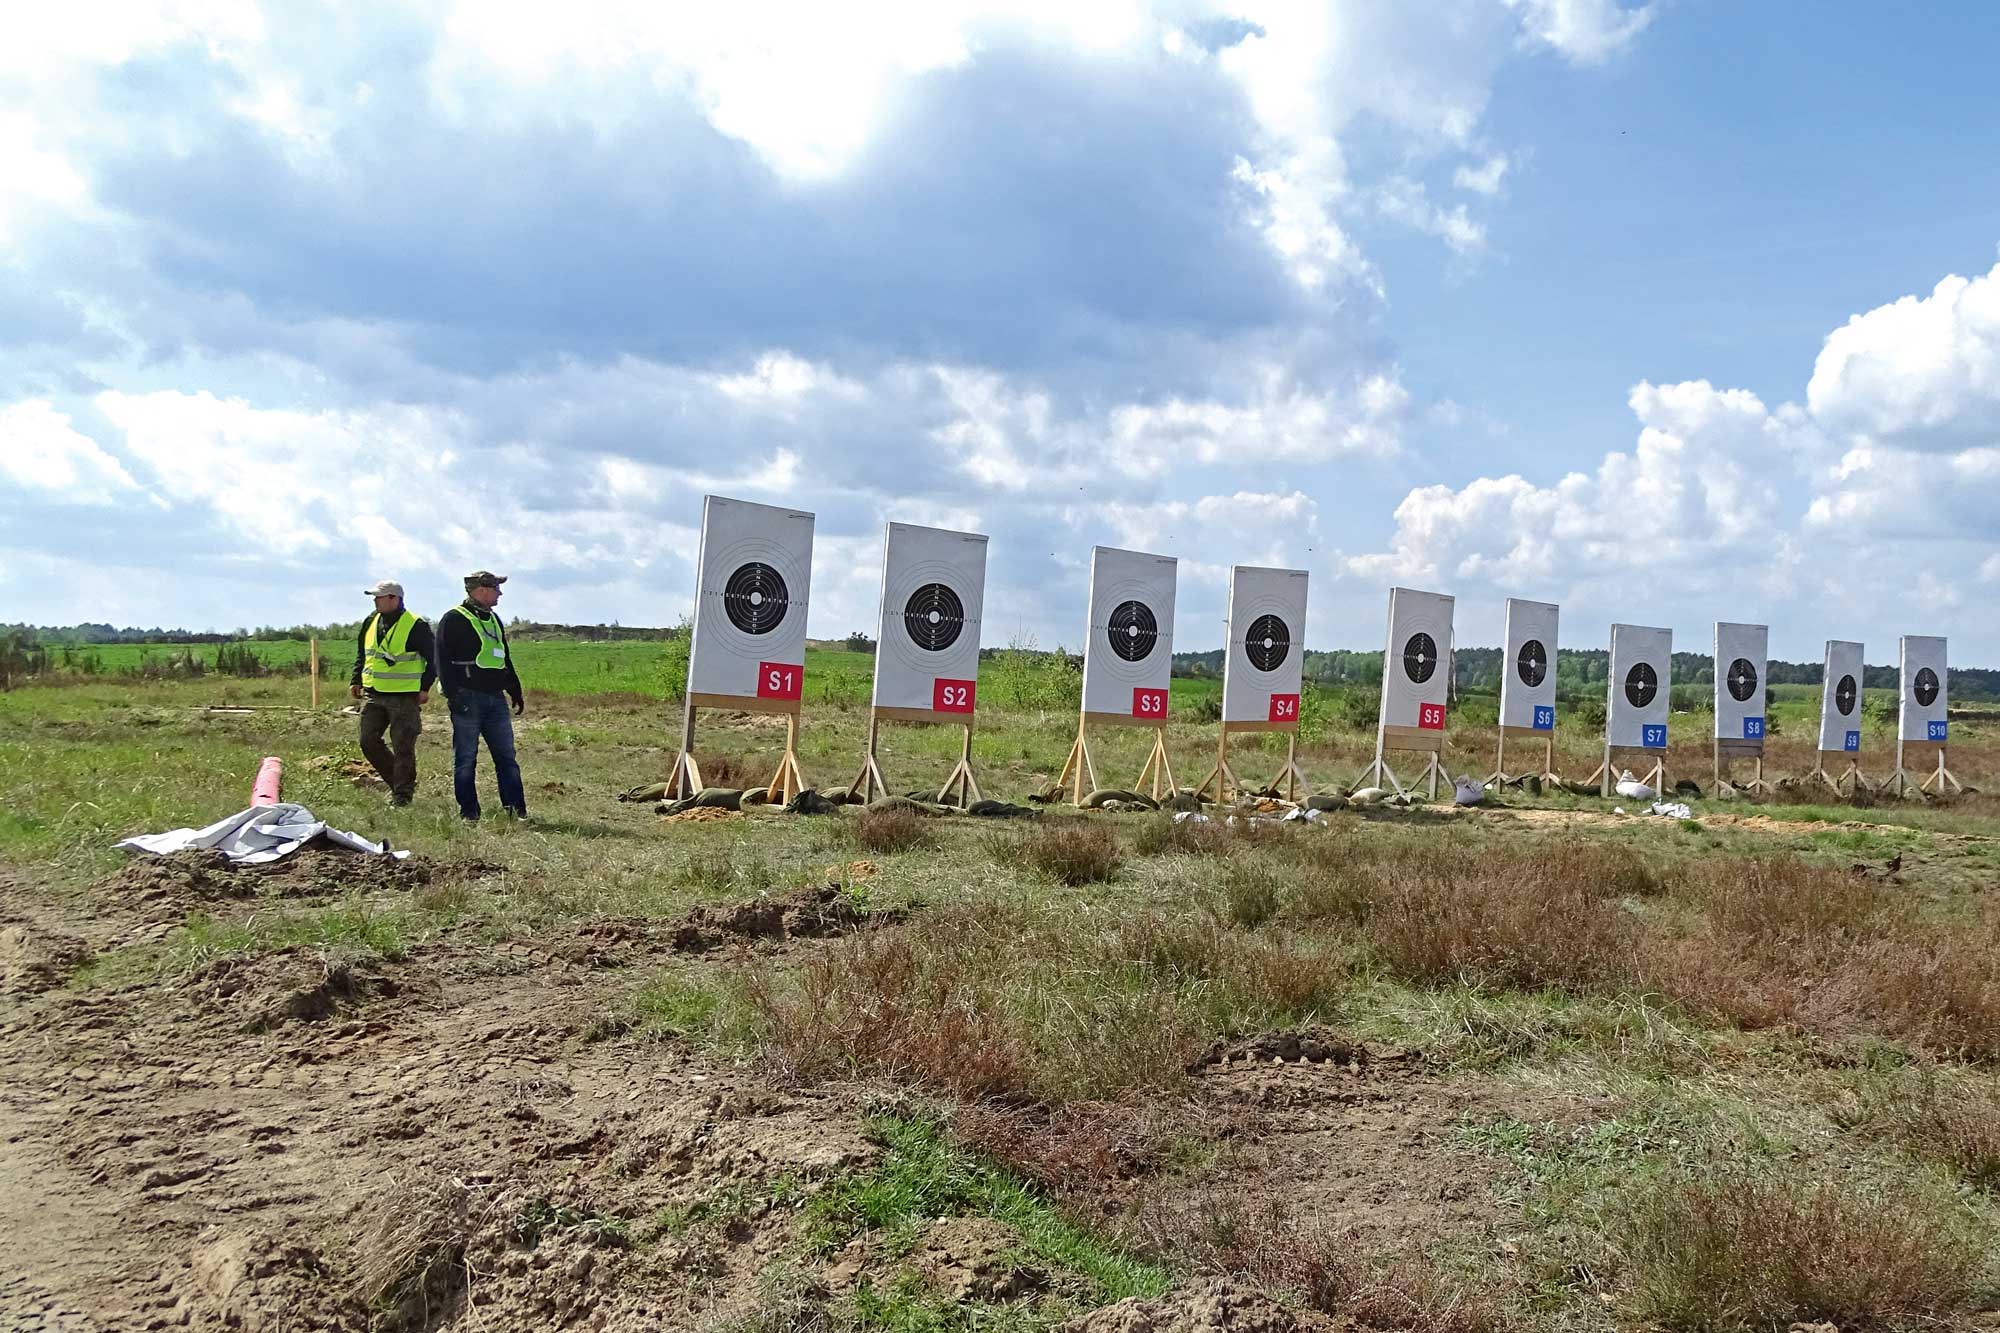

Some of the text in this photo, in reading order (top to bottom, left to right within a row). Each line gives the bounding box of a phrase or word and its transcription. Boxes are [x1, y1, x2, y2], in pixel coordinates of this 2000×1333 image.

[769, 671, 792, 691] S1
[943, 687, 966, 706] S2
[1141, 695, 1160, 712] S3
[1277, 700, 1293, 716] S4
[1424, 709, 1440, 724] S5
[1538, 711, 1550, 725] S6
[1748, 722, 1760, 734] S8
[1929, 725, 1946, 737] S10
[1647, 729, 1662, 742] S7
[1847, 735, 1857, 746] S9
